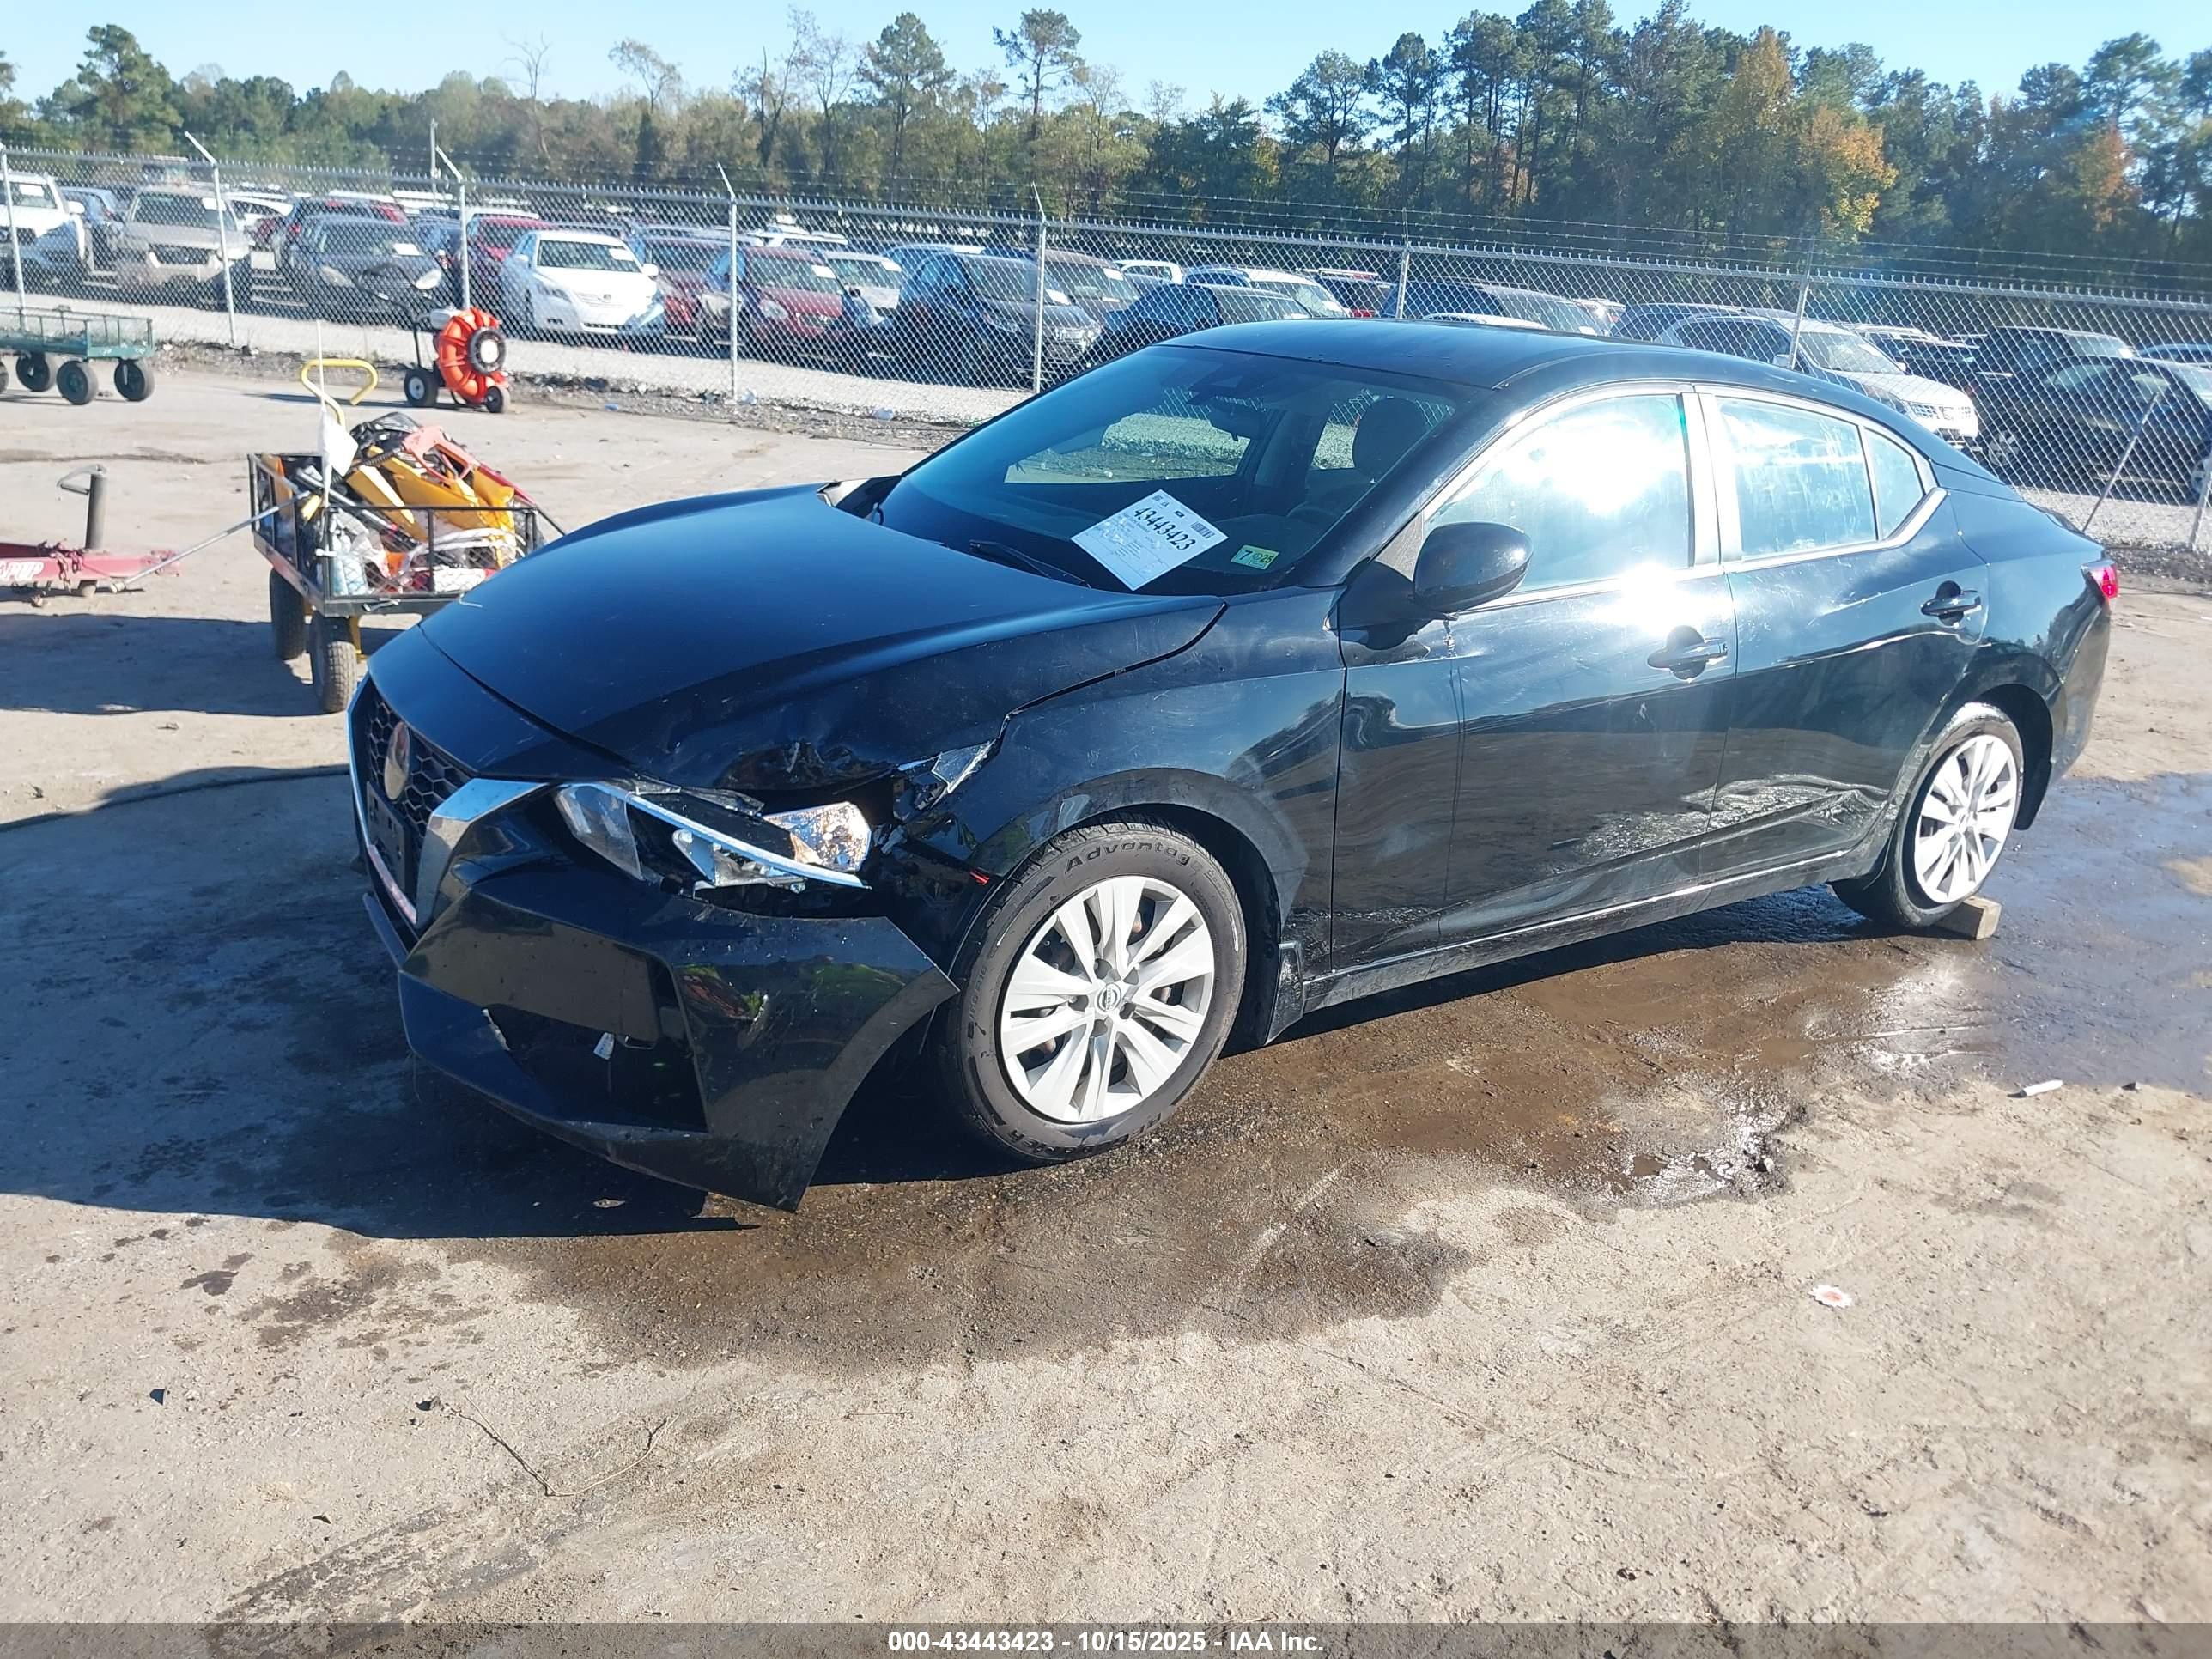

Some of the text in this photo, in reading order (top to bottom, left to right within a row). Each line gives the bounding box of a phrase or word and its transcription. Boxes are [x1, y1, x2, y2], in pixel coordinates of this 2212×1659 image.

[1133, 507, 1196, 550] 43443423
[1239, 550, 1274, 564] 7 25
